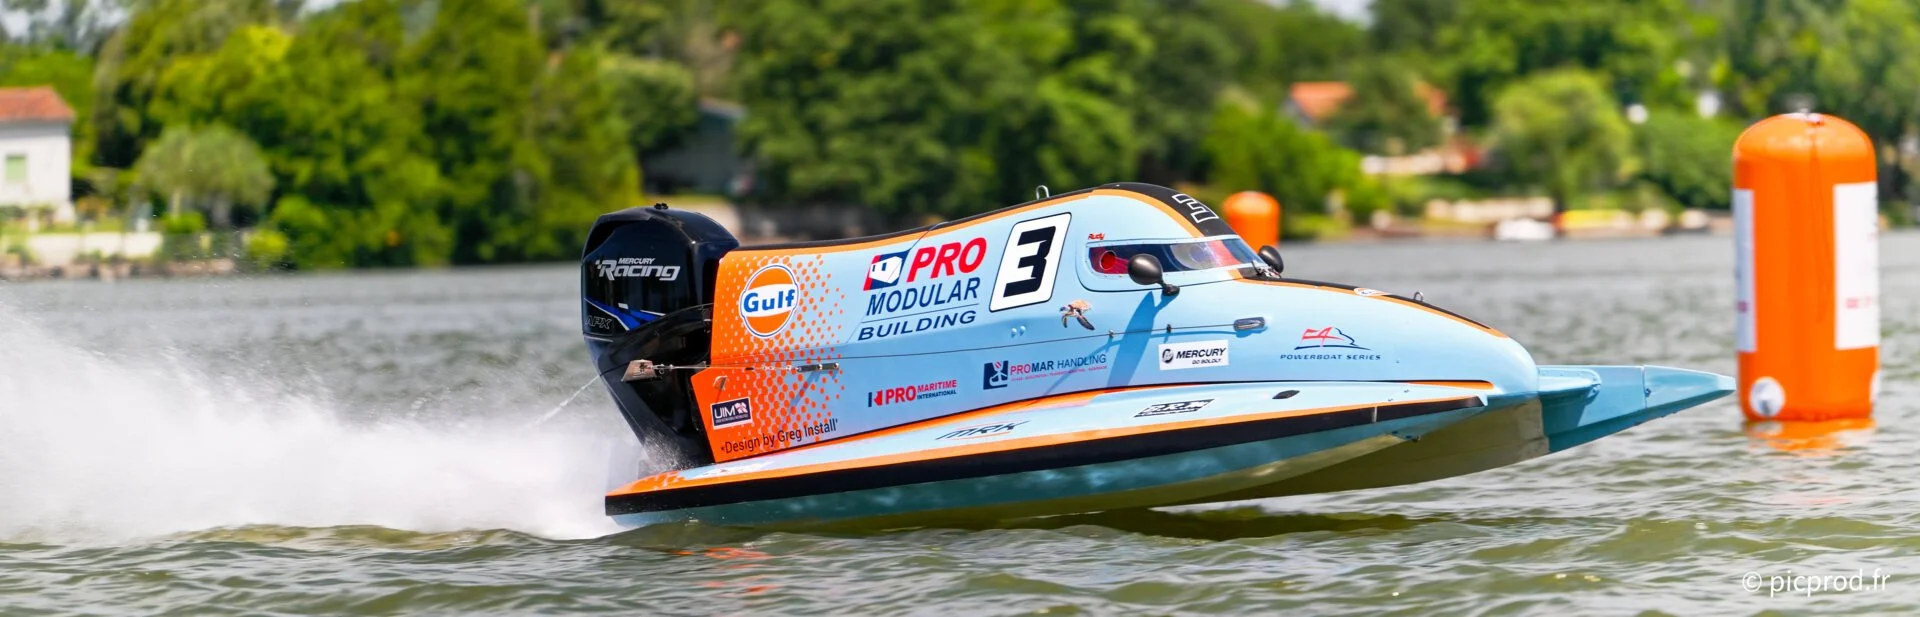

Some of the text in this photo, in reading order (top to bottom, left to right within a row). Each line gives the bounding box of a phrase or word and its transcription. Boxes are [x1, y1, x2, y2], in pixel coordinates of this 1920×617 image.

[595, 260, 681, 281] Racing
[906, 237, 987, 283] PRO
[1003, 226, 1057, 298] 3
[743, 289, 796, 313] Gulf
[866, 277, 981, 316] MODULAR
[857, 310, 977, 341] BUILDING
[1176, 348, 1227, 359] MERCURY
[1010, 361, 1054, 375] PROMAR
[1057, 354, 1107, 369] HANDLING
[886, 386, 917, 405] PRO
[917, 380, 957, 393] MARITIME
[917, 390, 957, 400] INTERNATIONAL
[714, 405, 736, 419] UIM
[763, 433, 775, 448] by
[777, 428, 802, 443] Greg
